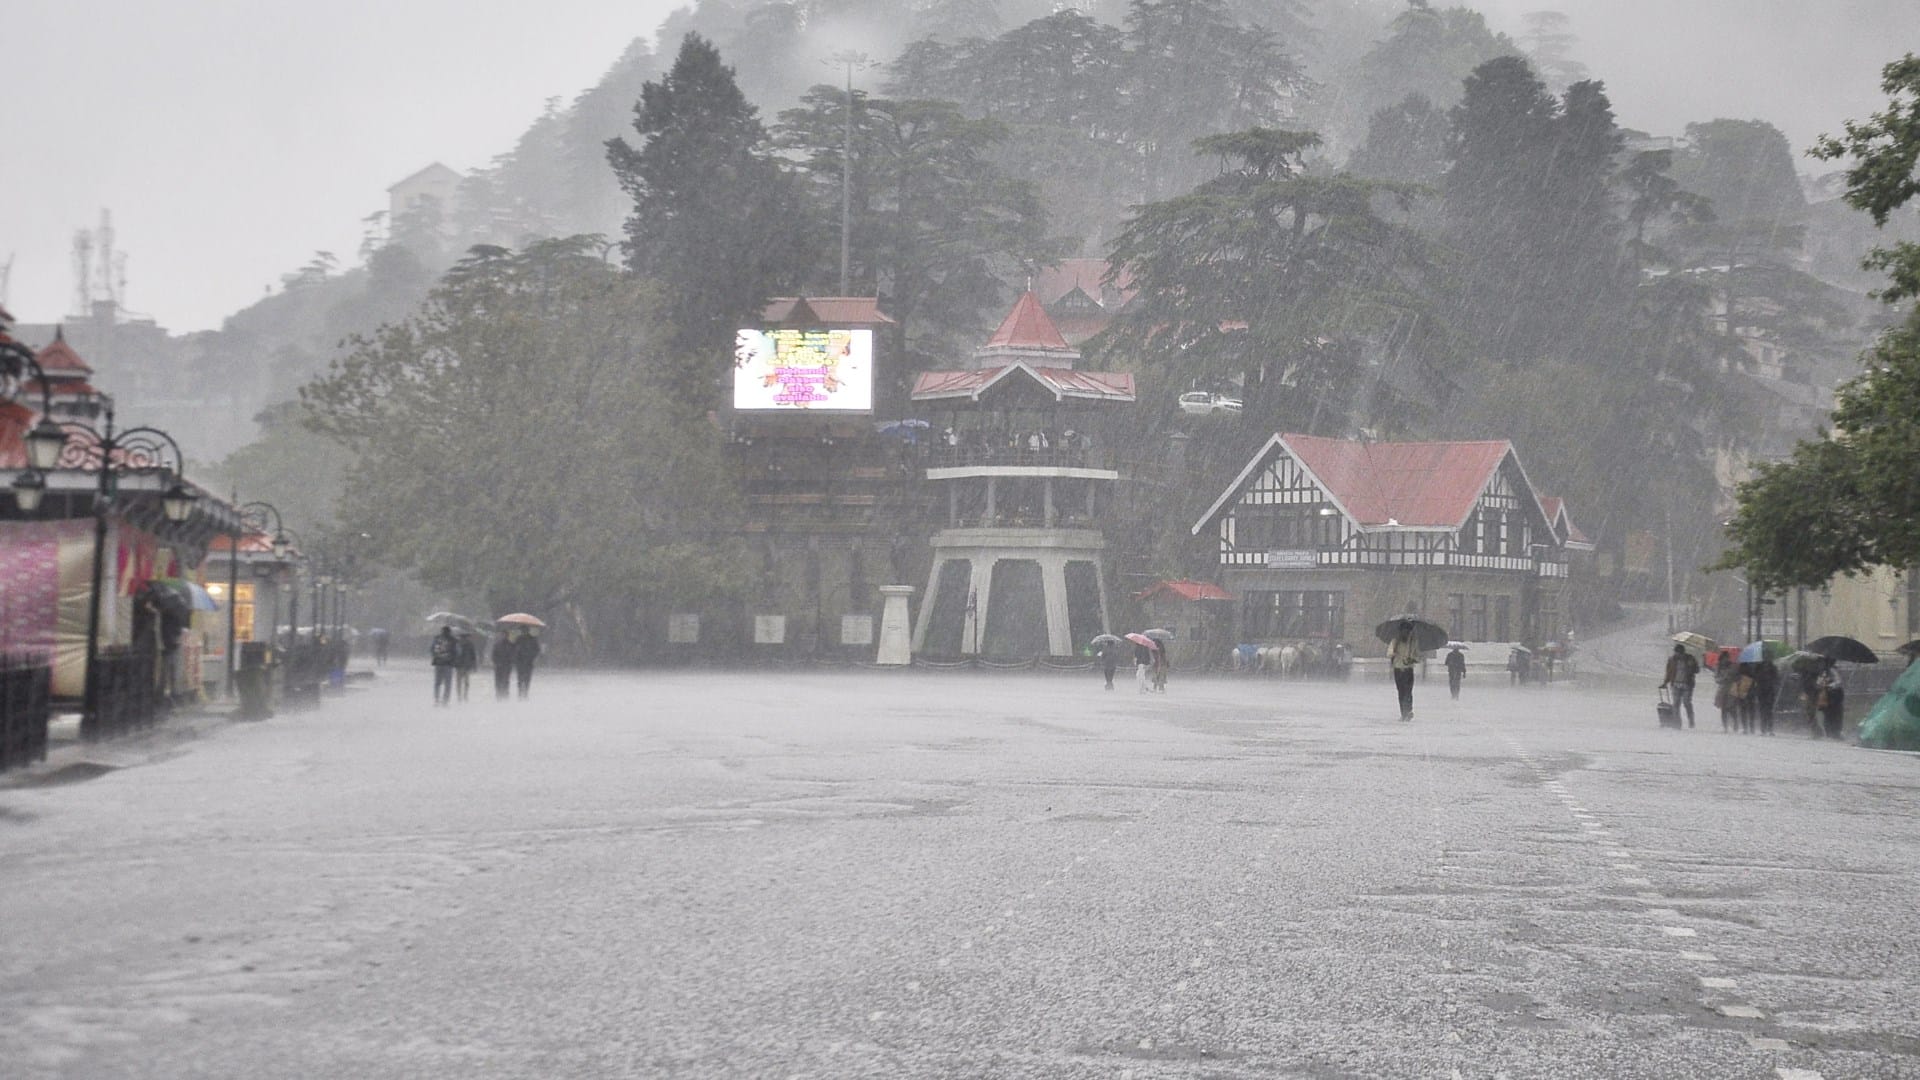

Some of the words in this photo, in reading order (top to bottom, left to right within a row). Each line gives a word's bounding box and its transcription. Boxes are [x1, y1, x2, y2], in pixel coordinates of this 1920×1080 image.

[777, 376, 825, 384] classes
[787, 384, 815, 393] also
[773, 393, 828, 402] available
